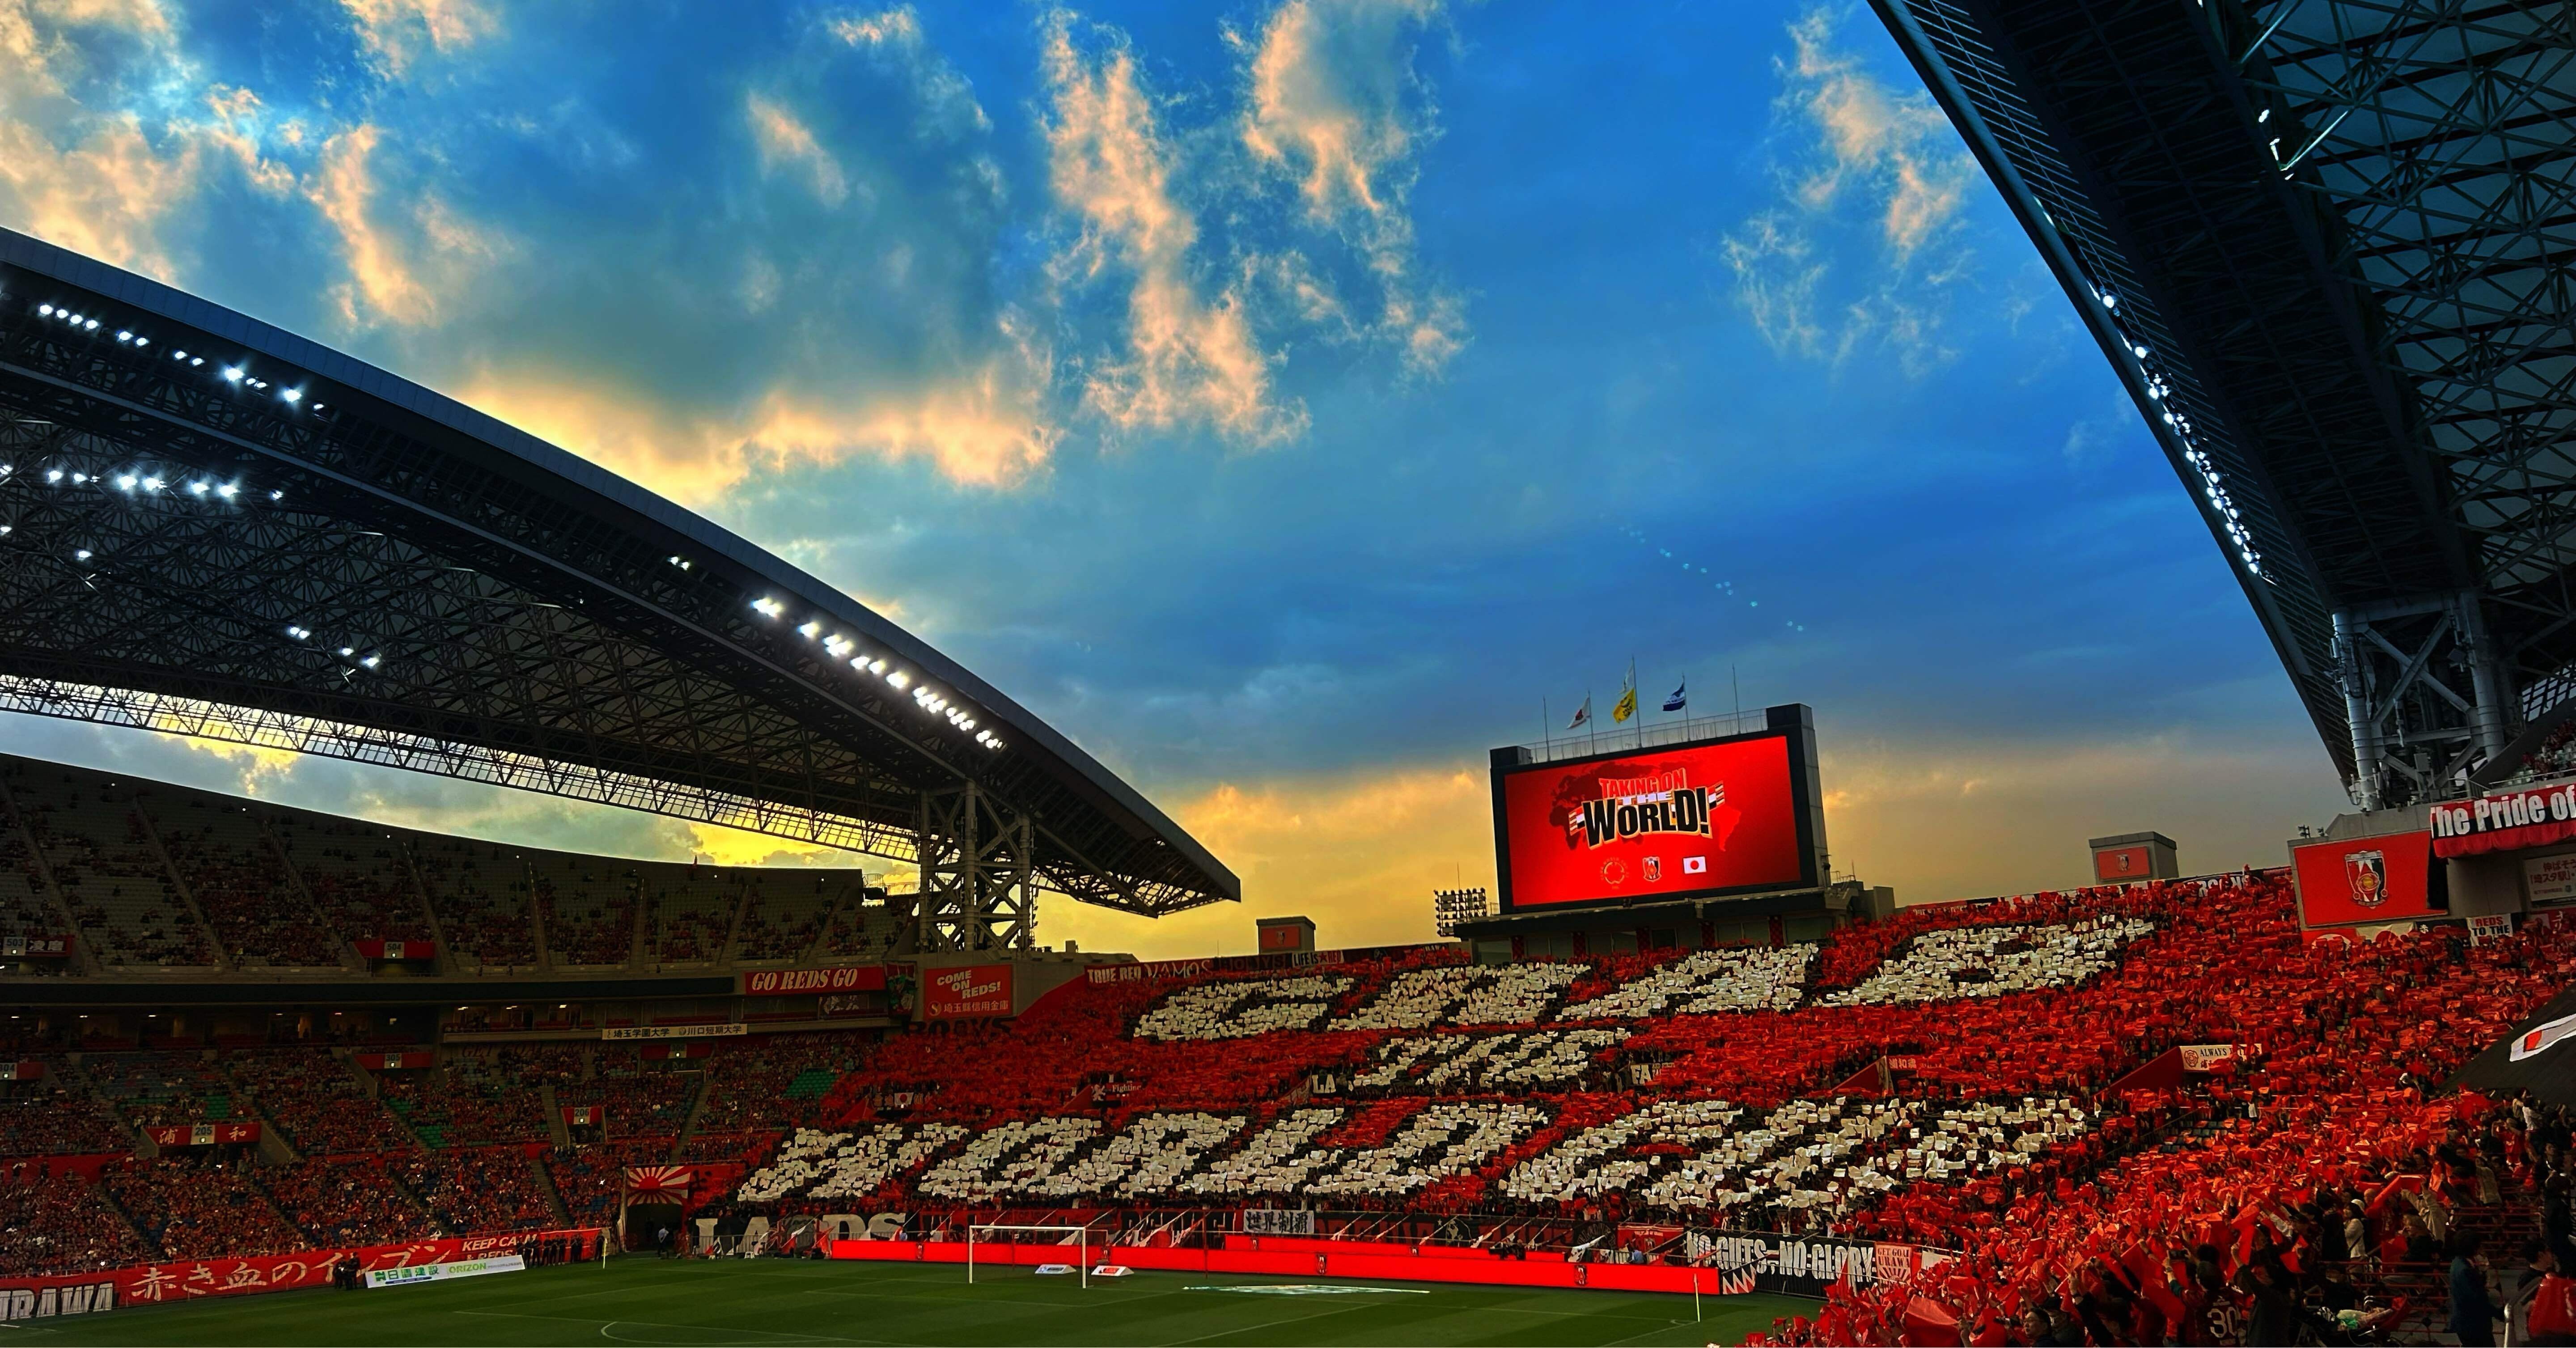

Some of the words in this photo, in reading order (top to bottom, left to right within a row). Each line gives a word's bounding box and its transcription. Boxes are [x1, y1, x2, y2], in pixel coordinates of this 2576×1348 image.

[1598, 776, 1660, 798] TAKING
[1661, 767, 1688, 793] ON
[1617, 791, 1673, 805] THE
[2474, 793, 2546, 832] Pride
[2551, 784, 2576, 820] of
[1582, 786, 1712, 849] WORLD!
[2476, 916, 2503, 927] REDS
[2472, 927, 2486, 937] TO
[2491, 925, 2510, 935] THE
[1293, 952, 1310, 967] LIFE
[1087, 967, 1116, 983] TRUE
[1144, 959, 1211, 979] VAMOS
[751, 972, 777, 991] GO
[780, 969, 830, 990] REDS
[833, 968, 858, 988] GO
[937, 970, 972, 986] COME
[952, 979, 970, 992] ON
[962, 981, 1001, 1000] REDS!
[2200, 1048, 2227, 1057] ALWAYS
[575, 1109, 589, 1117] 206
[195, 1127, 212, 1136] 205
[462, 1237, 496, 1251] KEEP
[499, 1233, 538, 1247] CAM
[449, 1263, 487, 1274] ORIZON
